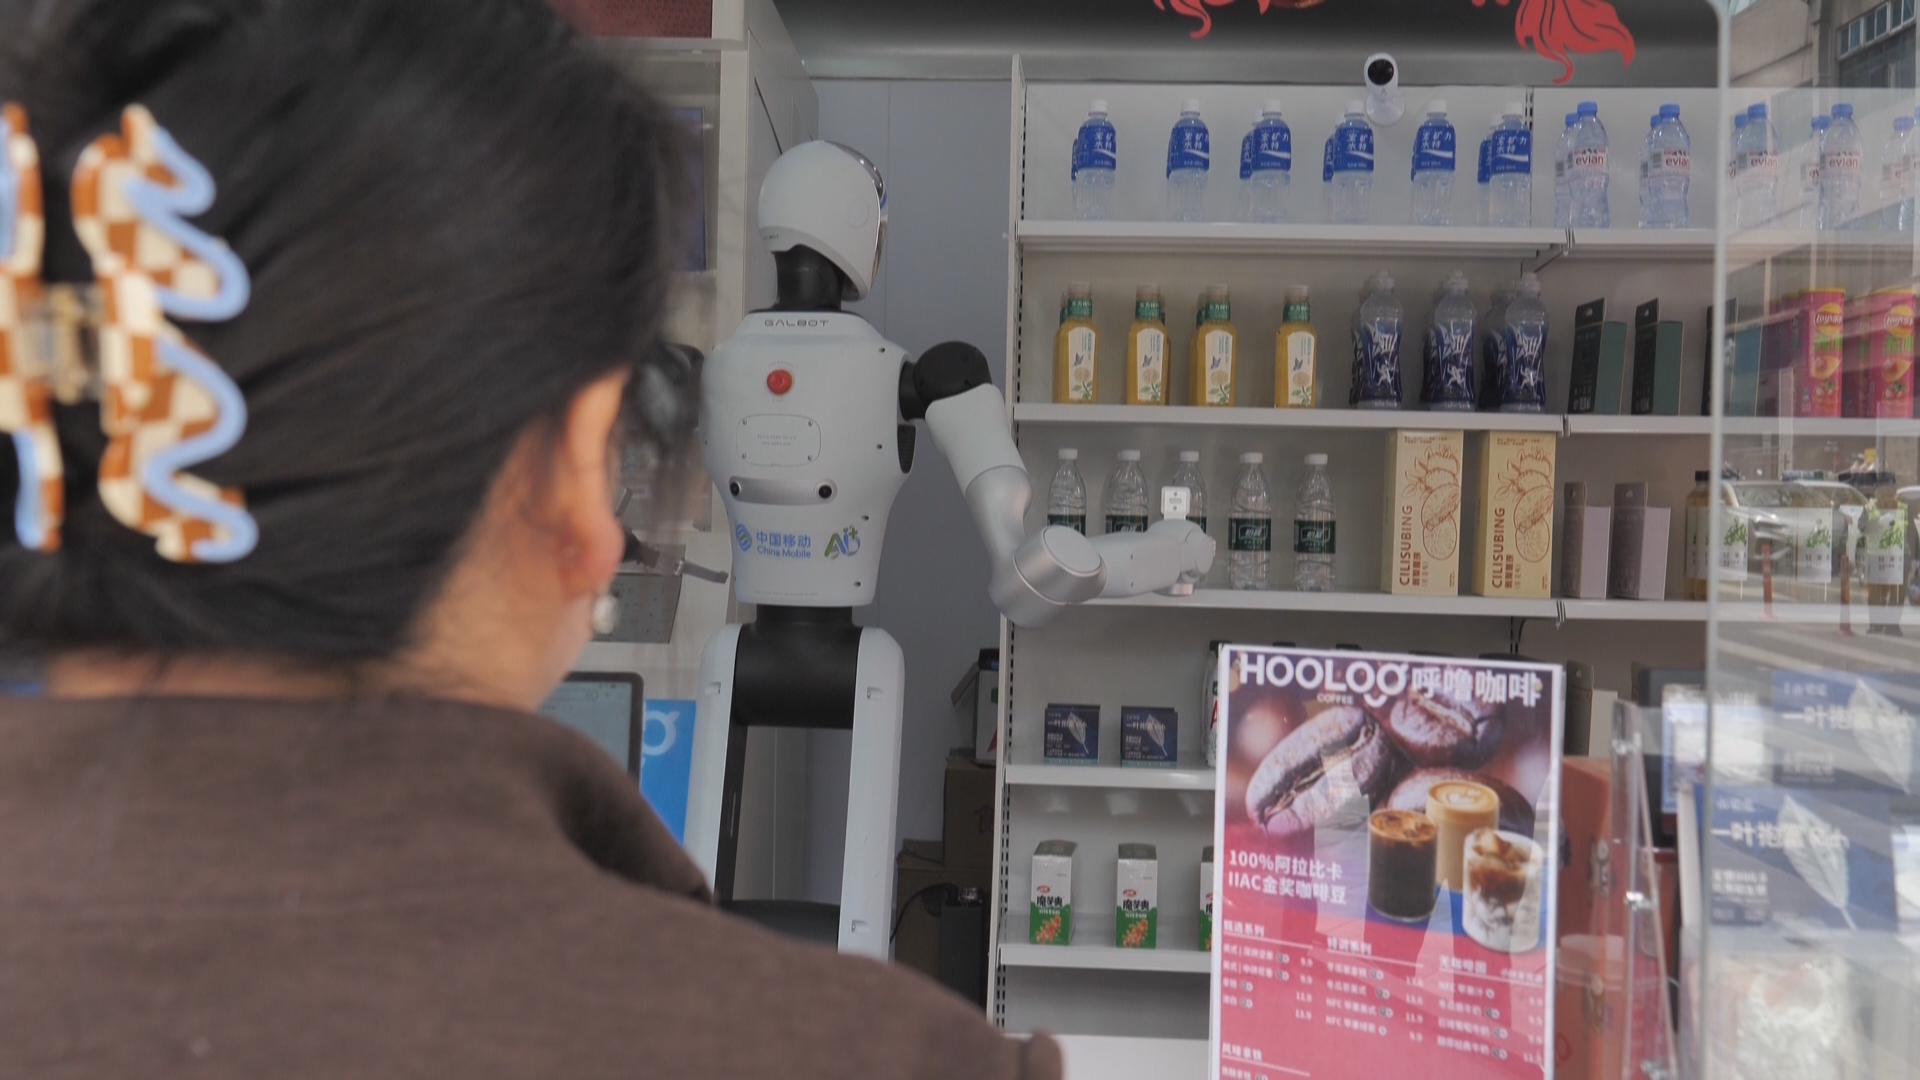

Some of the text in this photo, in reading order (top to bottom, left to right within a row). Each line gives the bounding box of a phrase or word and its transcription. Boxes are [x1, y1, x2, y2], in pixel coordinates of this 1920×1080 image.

[1575, 155, 1604, 166] evian
[1751, 157, 1778, 168] evian
[1829, 157, 1858, 168] evian
[764, 319, 829, 327] GALBOT
[756, 531, 811, 549] 中国移动
[1399, 505, 1413, 586] CILISUBING
[756, 545, 812, 559] China Mobile
[1492, 507, 1505, 589] CILISUBING
[1411, 664, 1542, 707] 呼噜咖啡
[1317, 692, 1354, 705] COFFEE
[1229, 849, 1343, 882] 100%阿拉比卡
[1228, 870, 1347, 906] IIAC金奖咖啡豆
[1036, 894, 1063, 908] 魔芋爽
[1122, 898, 1150, 912] 魔芋爽
